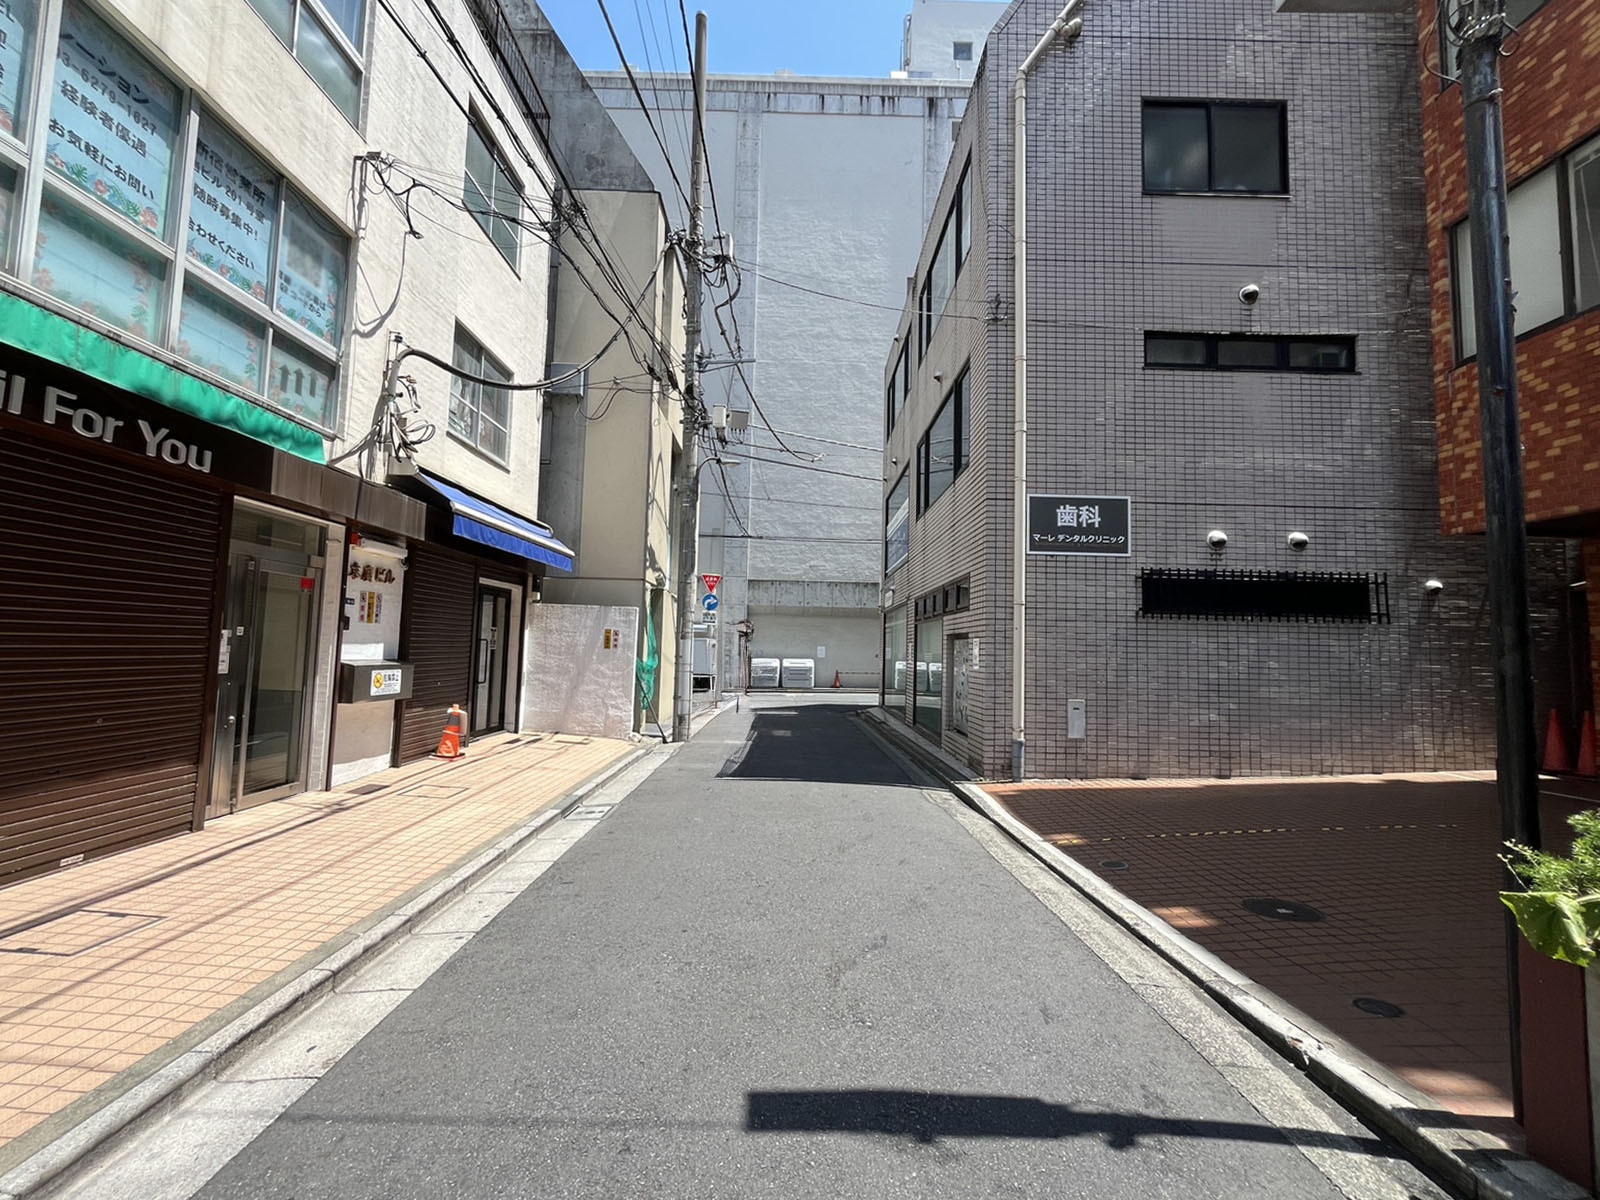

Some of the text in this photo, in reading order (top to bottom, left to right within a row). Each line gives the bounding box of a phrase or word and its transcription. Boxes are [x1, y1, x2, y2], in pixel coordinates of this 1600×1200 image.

[57, 45, 157, 136] 3-6279-1627
[59, 33, 150, 104] ーション
[48, 117, 155, 200] お気軽にお問い
[60, 80, 147, 158] 経験者優遇
[43, 385, 124, 443] For
[137, 419, 213, 474] You
[1056, 504, 1102, 528] 歯科
